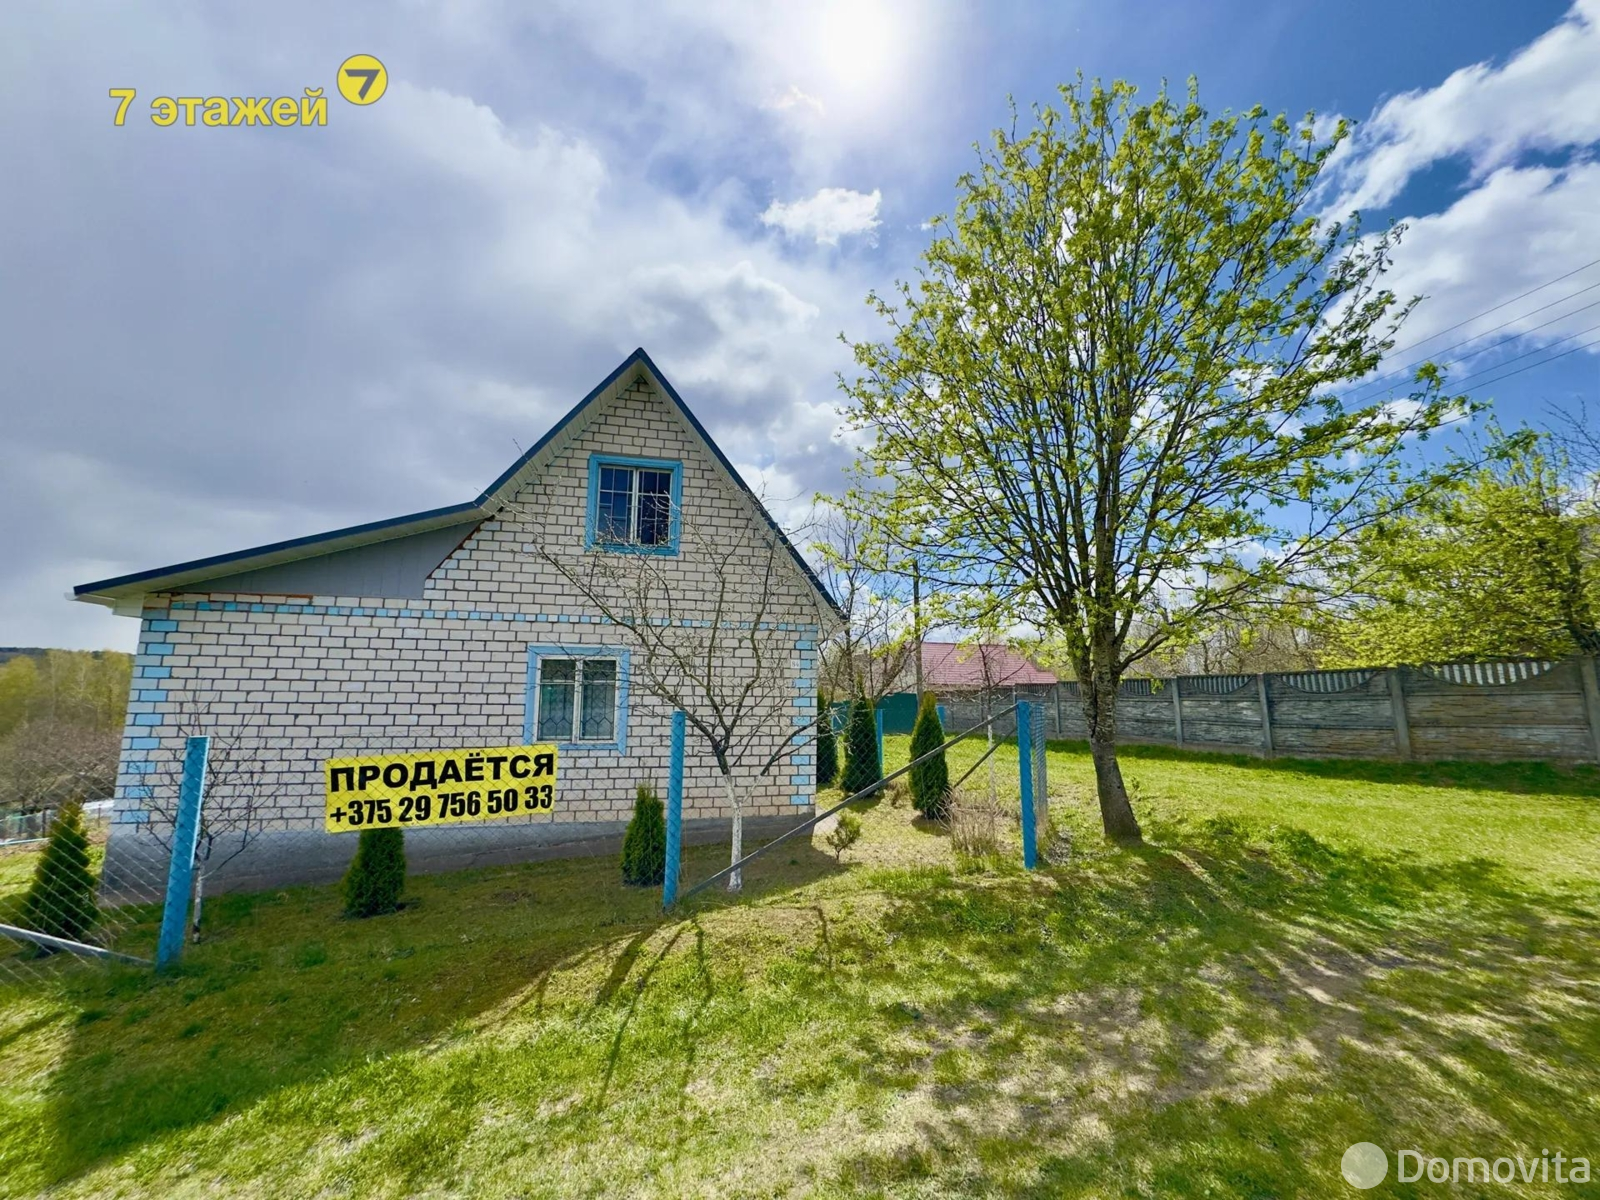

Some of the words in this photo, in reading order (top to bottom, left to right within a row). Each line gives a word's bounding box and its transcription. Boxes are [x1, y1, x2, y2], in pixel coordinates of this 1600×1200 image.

[330, 752, 554, 792] ПРОДАЁТСЯ
[330, 799, 392, 826] +375
[399, 795, 431, 822] 29
[437, 791, 481, 818] 756
[487, 788, 518, 814] 50
[524, 784, 553, 809] 33
